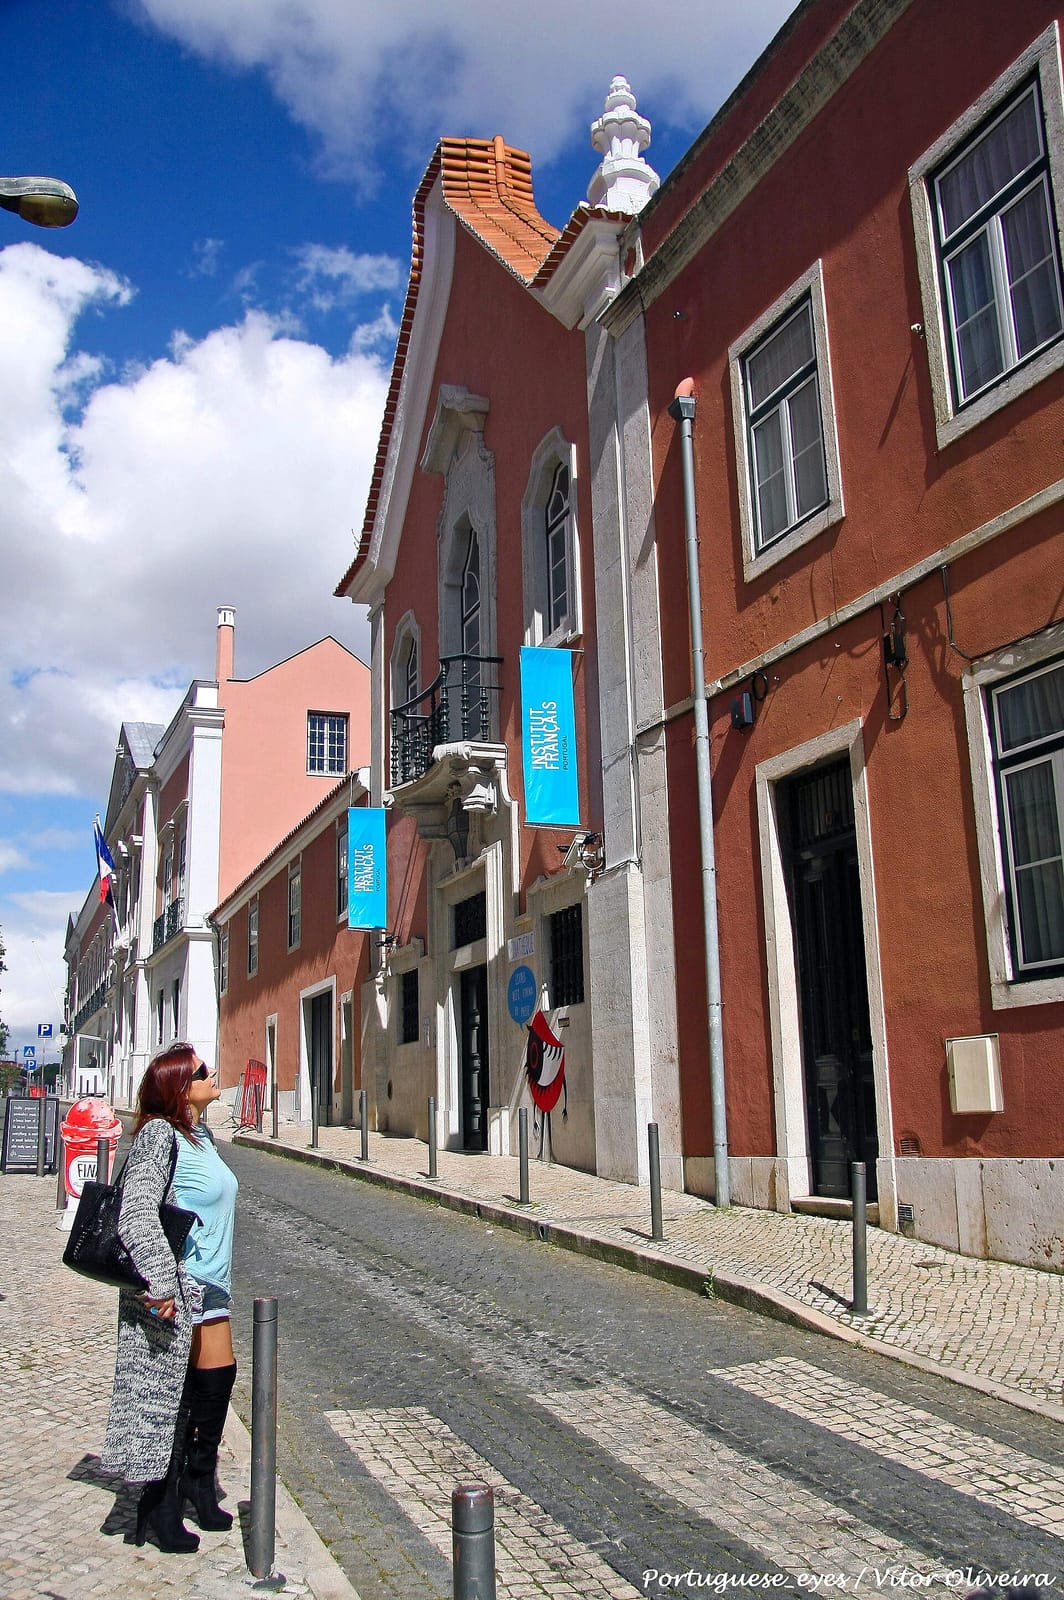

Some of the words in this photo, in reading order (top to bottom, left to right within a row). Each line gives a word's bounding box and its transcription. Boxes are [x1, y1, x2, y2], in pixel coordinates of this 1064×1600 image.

[530, 708, 545, 769] INSTITUT
[542, 701, 560, 769] FRANÇAIS
[354, 849, 366, 892] INSTITUT
[363, 844, 375, 892] FRANÇAIS
[41, 1025, 50, 1036] P
[28, 1061, 35, 1070] P
[77, 1163, 97, 1178] FIN
